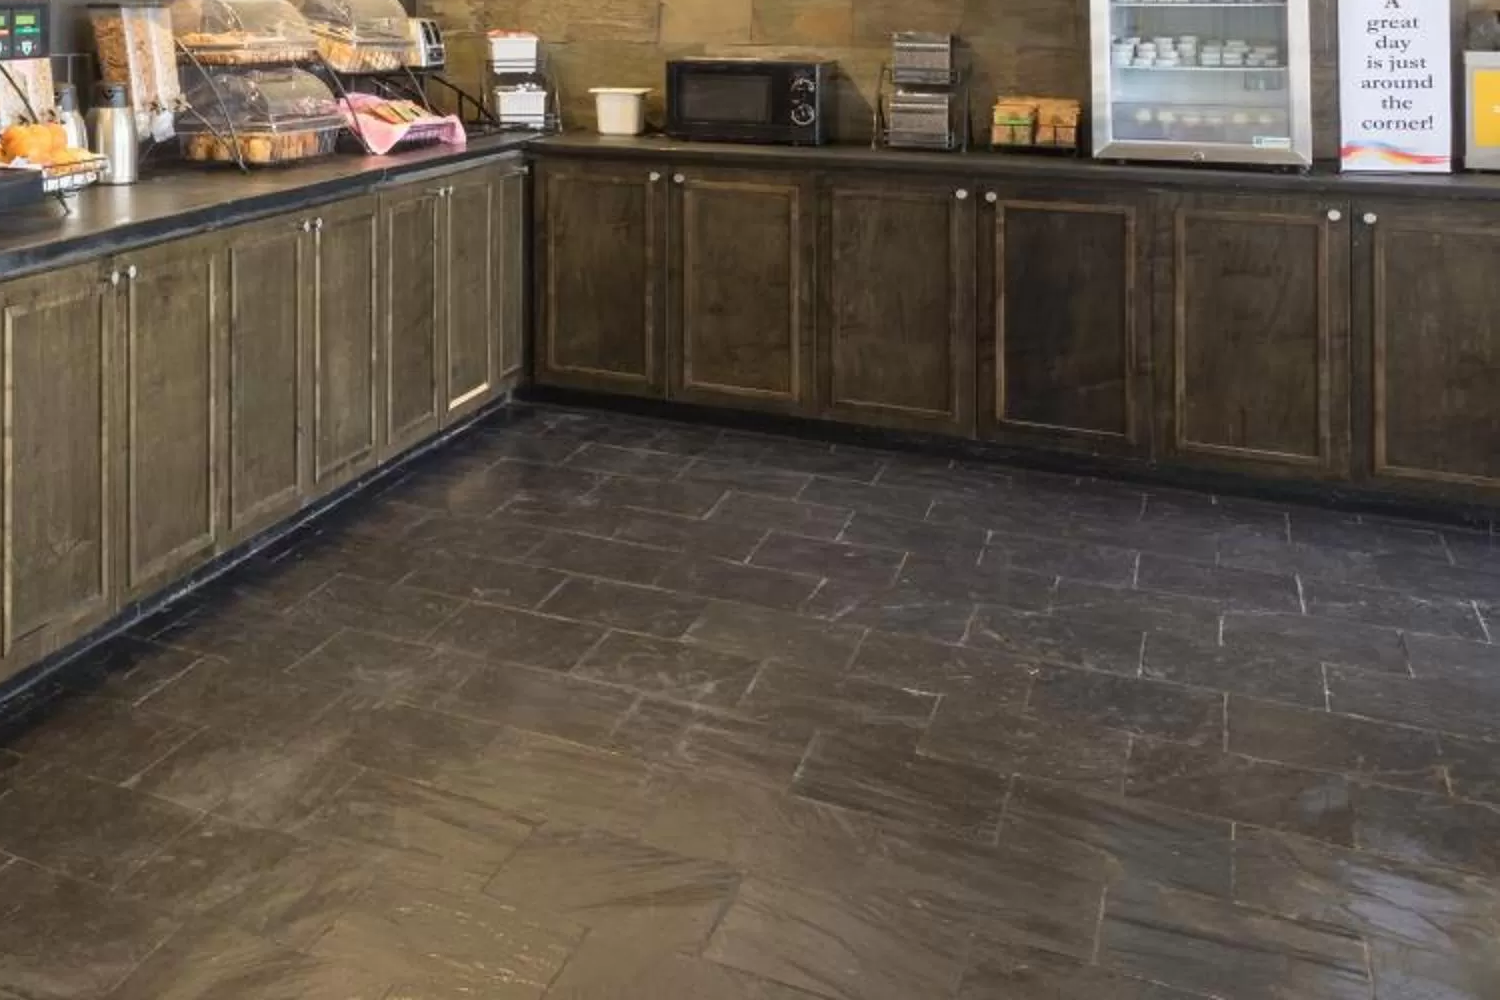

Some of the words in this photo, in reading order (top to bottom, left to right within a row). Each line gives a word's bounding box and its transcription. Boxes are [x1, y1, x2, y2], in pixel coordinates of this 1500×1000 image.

[1366, 17, 1420, 33] great
[1375, 35, 1411, 53] day
[1367, 55, 1383, 69] is
[1388, 55, 1428, 73] just
[1361, 74, 1433, 89] around
[1381, 95, 1413, 110] the
[1361, 115, 1434, 131] corner!
